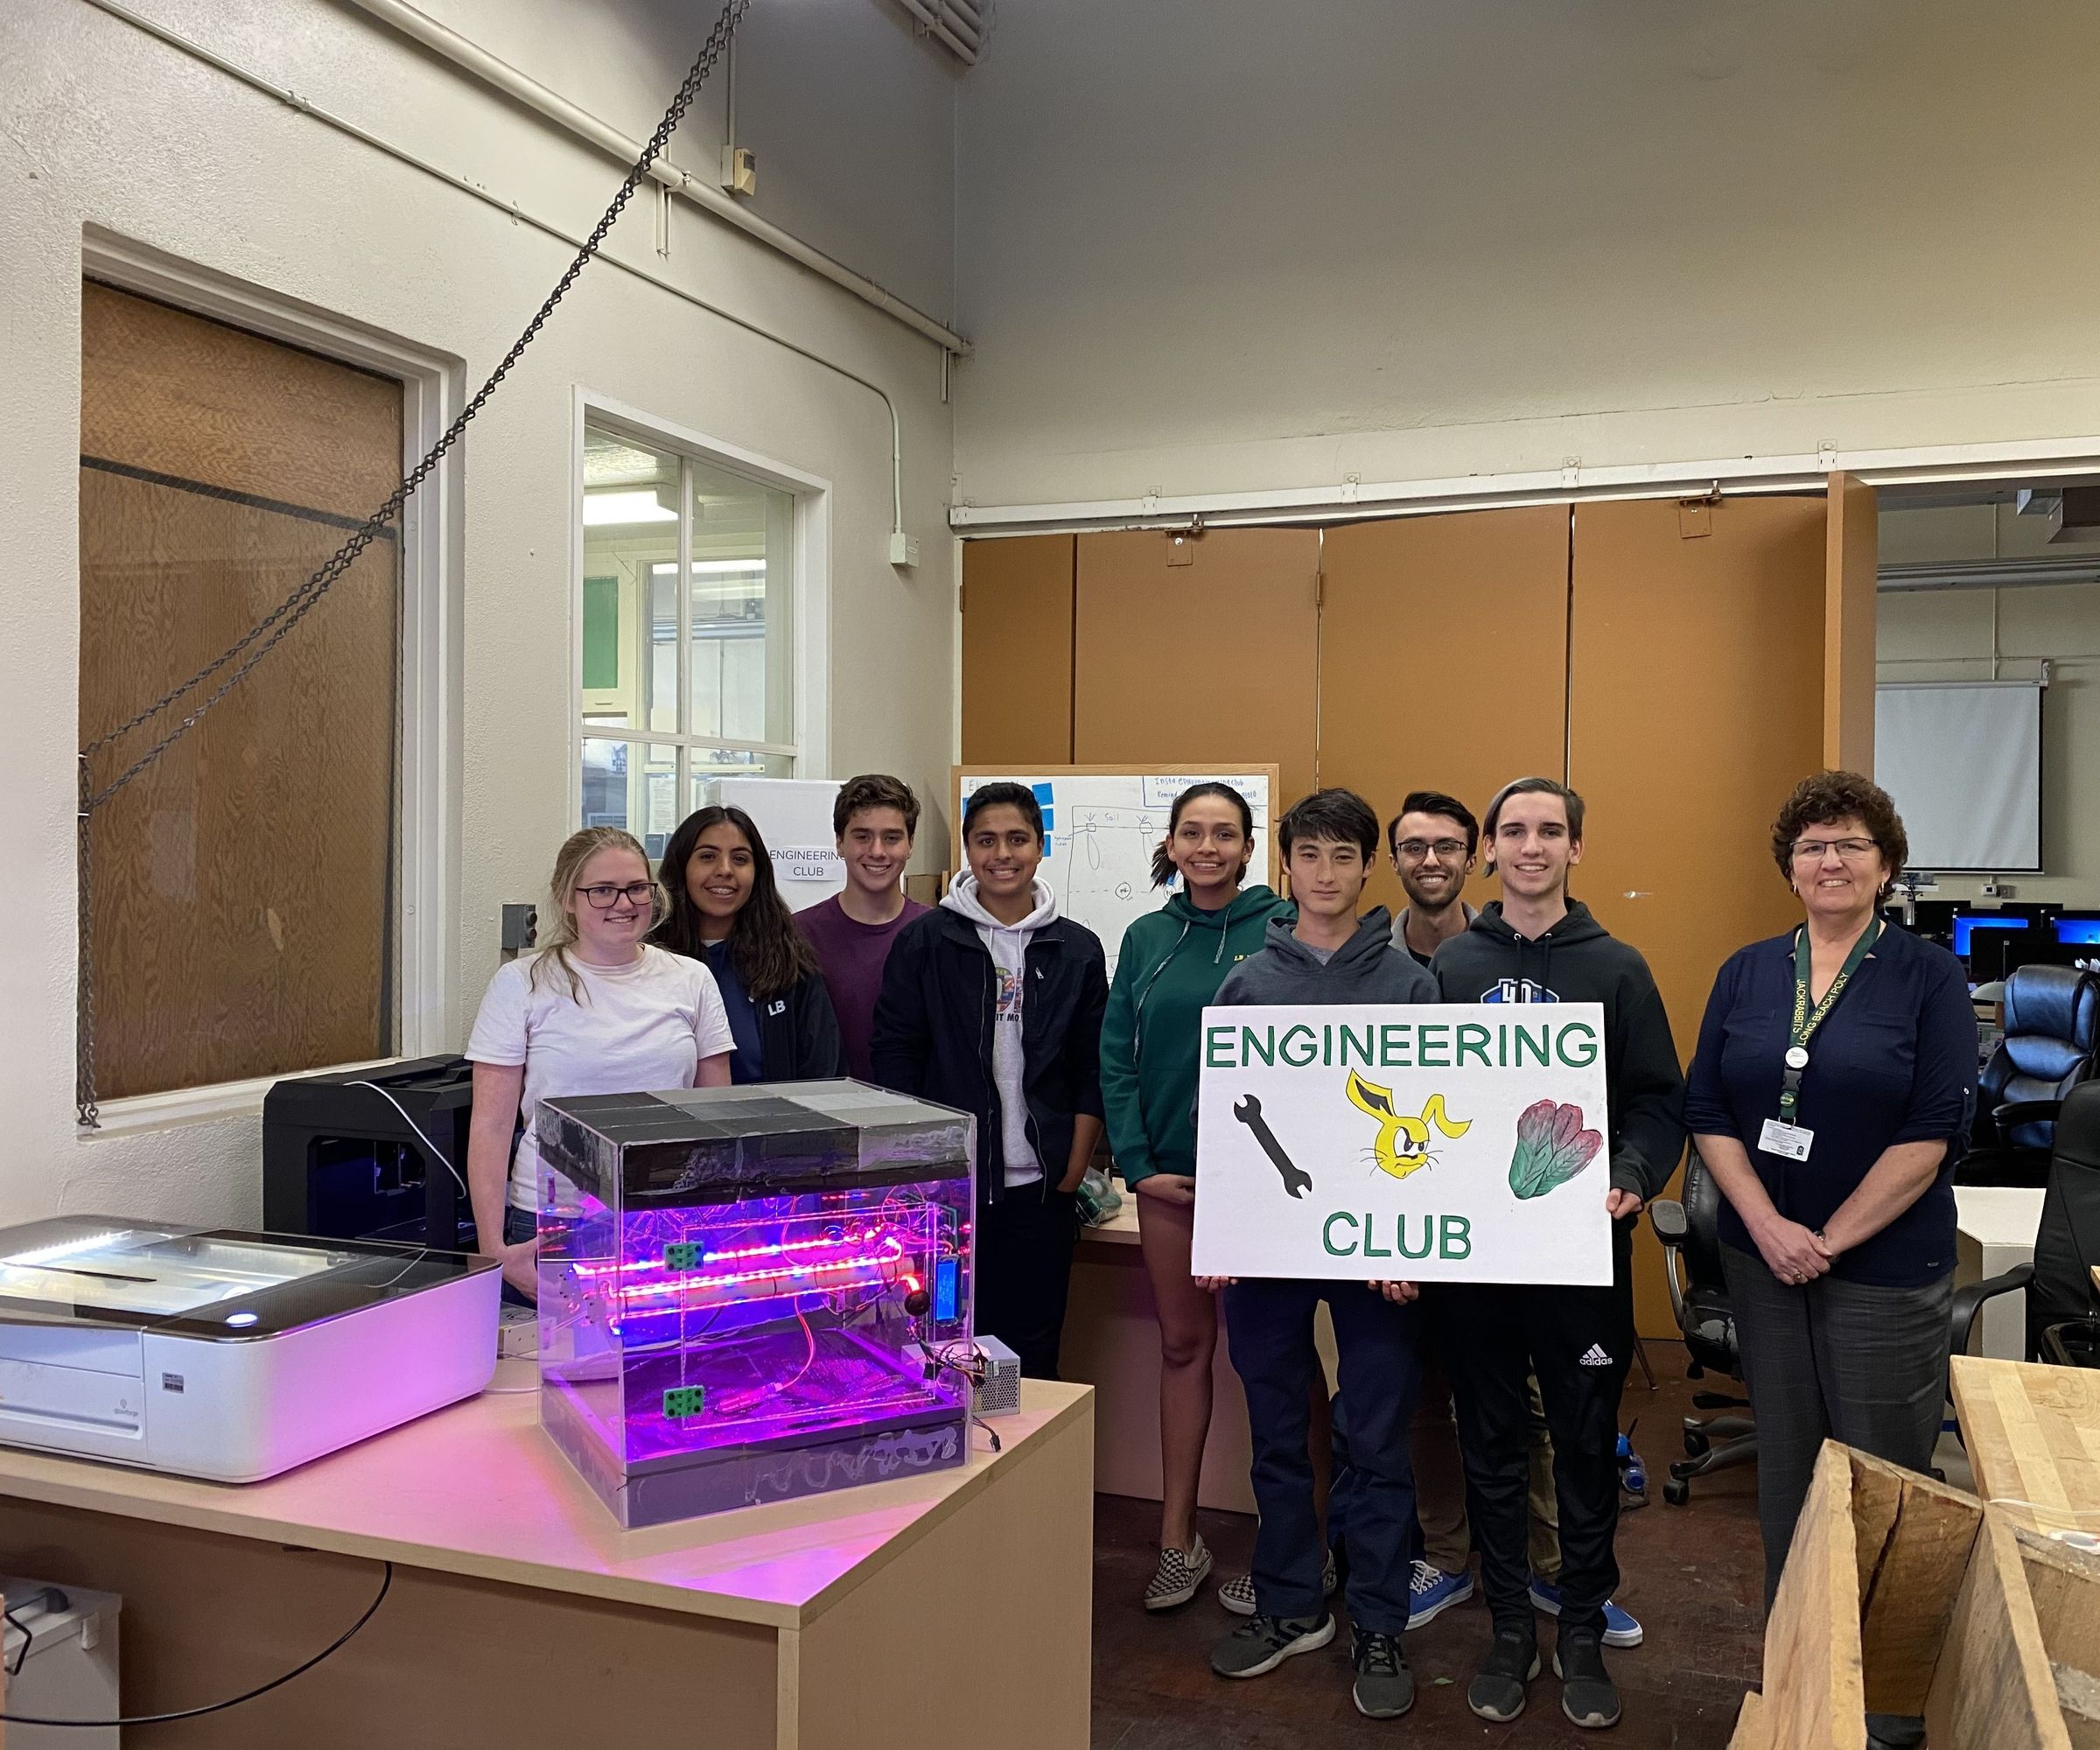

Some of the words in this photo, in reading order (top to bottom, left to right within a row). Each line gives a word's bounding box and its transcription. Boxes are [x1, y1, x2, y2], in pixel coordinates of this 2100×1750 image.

[770, 850, 844, 861] ENGINEERIN
[793, 866, 824, 877] CLUB
[767, 999, 786, 1016] LB
[1792, 979, 1807, 1033] JACKRABBITS
[1796, 1022, 1817, 1046] LONG
[1811, 994, 1837, 1022] BEACH
[1830, 972, 1850, 994] POLY
[1206, 1022, 1599, 1068] ENGINEERING
[1322, 1211, 1472, 1260] CLUB
